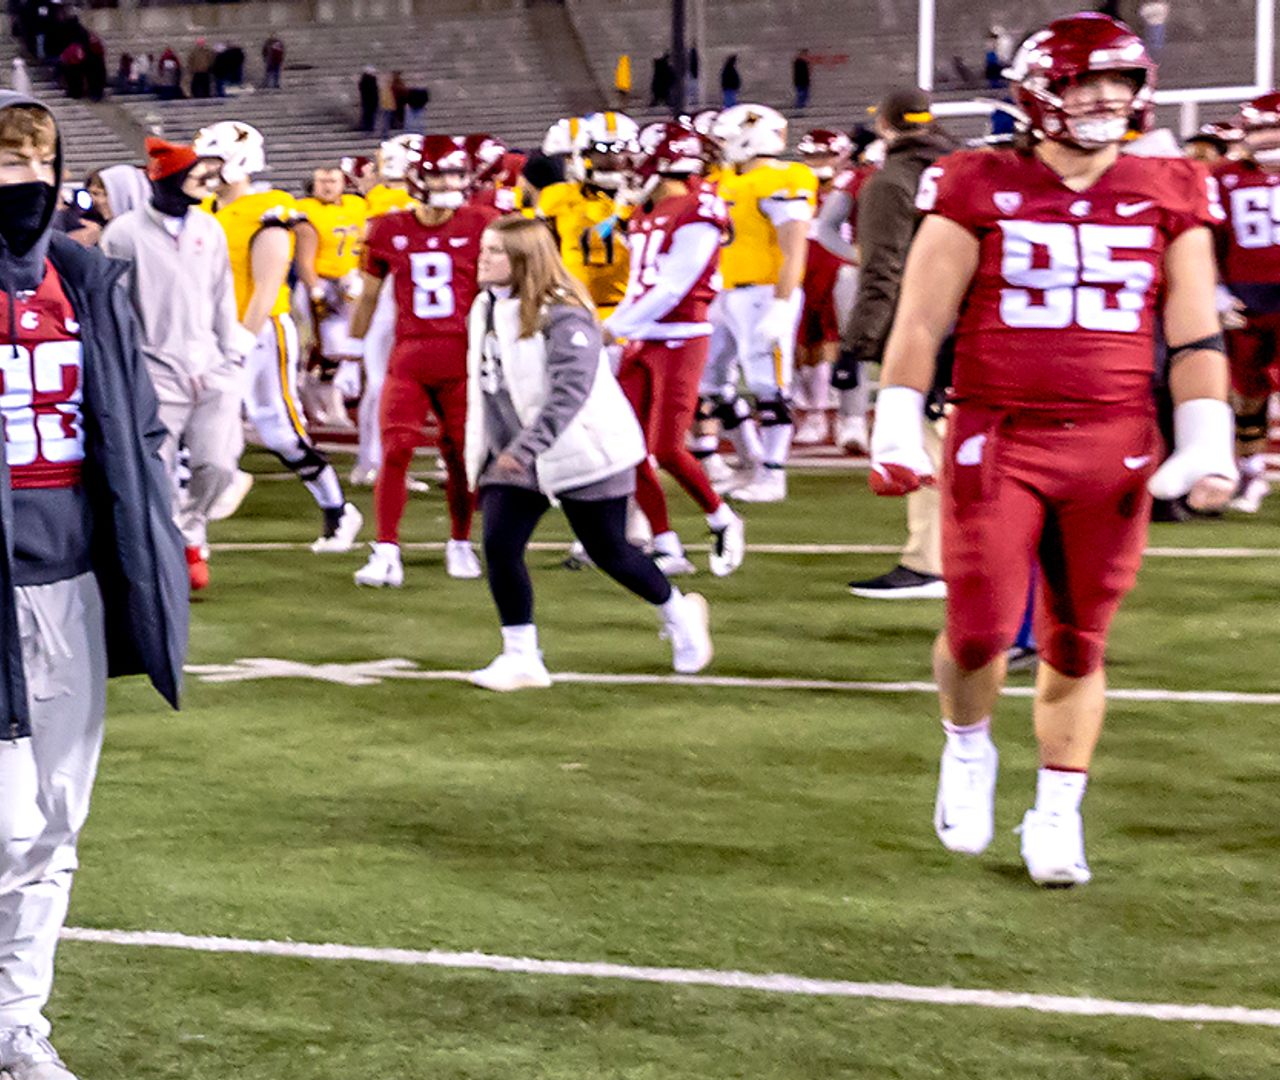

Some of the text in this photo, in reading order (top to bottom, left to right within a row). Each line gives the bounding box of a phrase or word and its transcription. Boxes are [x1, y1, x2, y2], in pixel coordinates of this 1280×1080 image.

[1230, 186, 1280, 249] 6
[408, 251, 456, 319] 8
[996, 219, 1155, 332] 95
